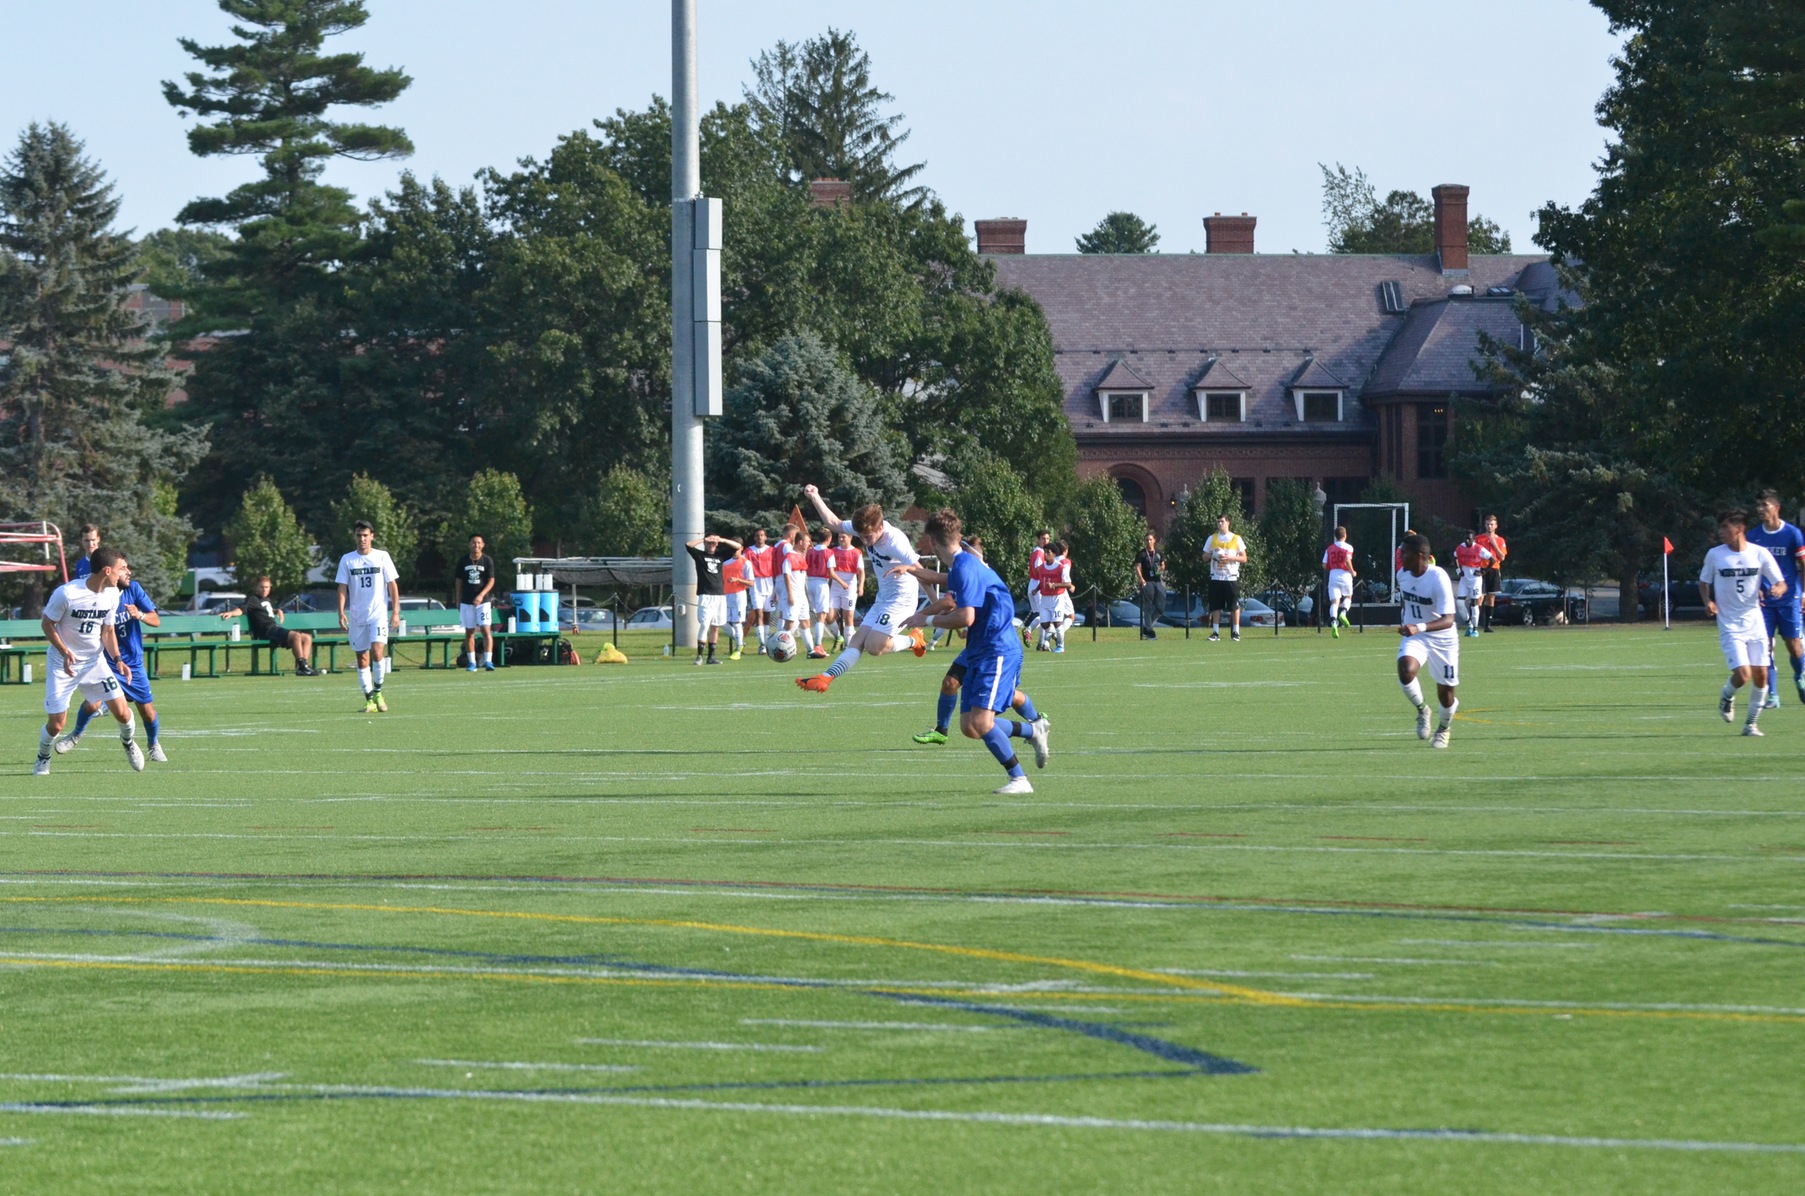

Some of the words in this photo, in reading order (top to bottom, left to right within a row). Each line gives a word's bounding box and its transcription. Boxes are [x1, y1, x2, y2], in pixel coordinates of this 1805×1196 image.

[361, 577, 372, 588] 13
[1736, 580, 1744, 593] 5
[1411, 605, 1422, 619] 11
[875, 613, 890, 625] 18
[79, 621, 94, 633] 16
[1444, 665, 1454, 679] 11
[101, 676, 118, 693] 16
